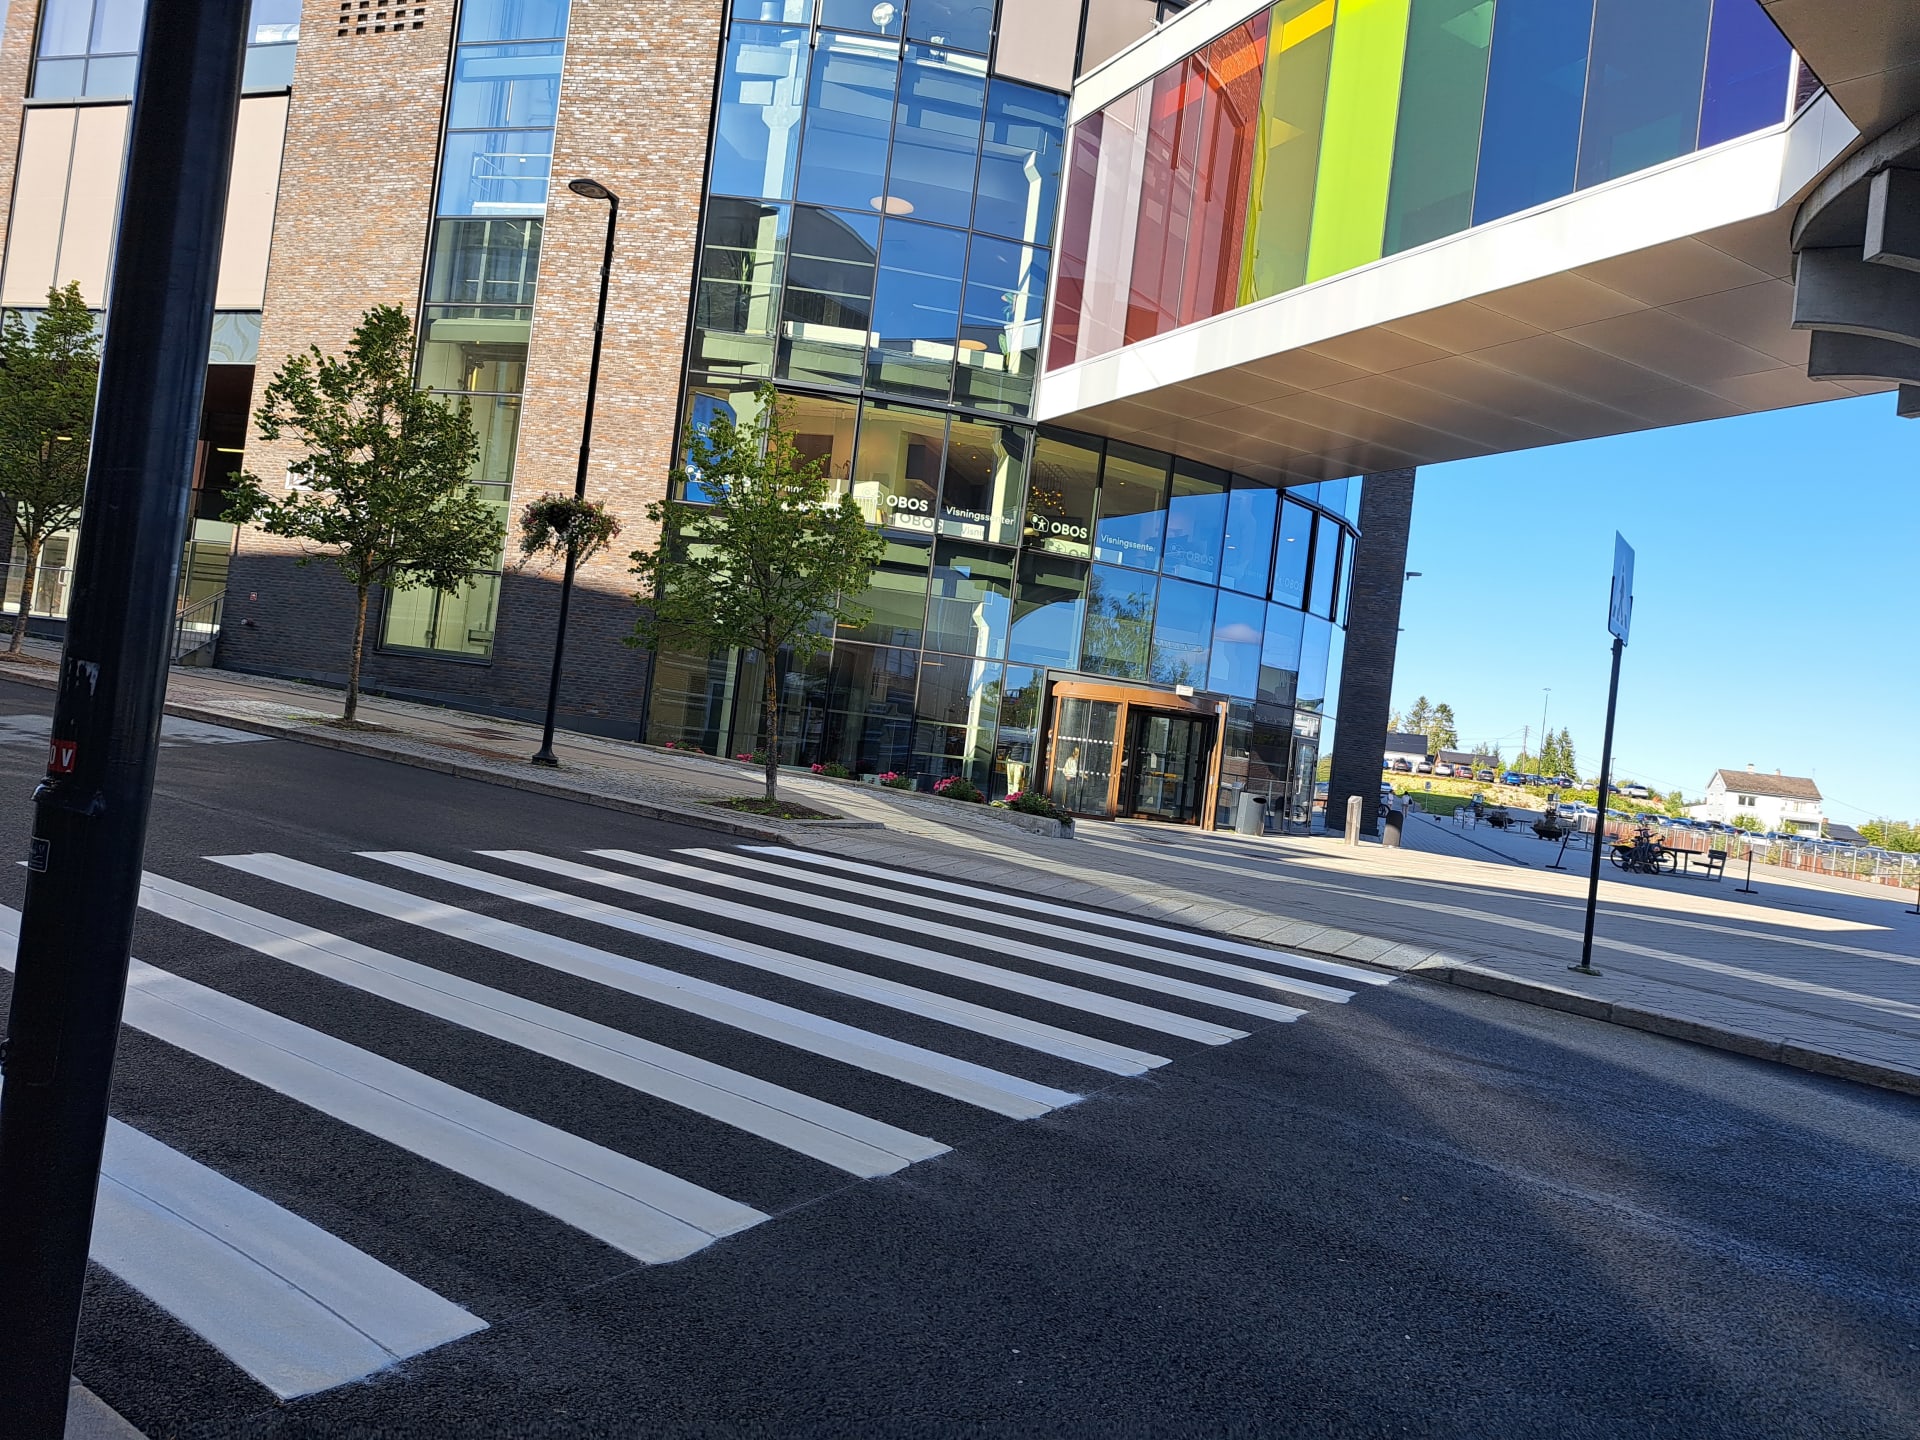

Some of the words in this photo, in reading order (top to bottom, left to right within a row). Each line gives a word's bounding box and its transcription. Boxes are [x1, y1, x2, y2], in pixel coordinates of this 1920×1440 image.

[886, 494, 929, 512] OBOS
[946, 505, 1015, 526] Visningssenter
[1050, 522, 1088, 539] OBOS
[1186, 551, 1214, 567] OBOS
[61, 747, 73, 768] V
